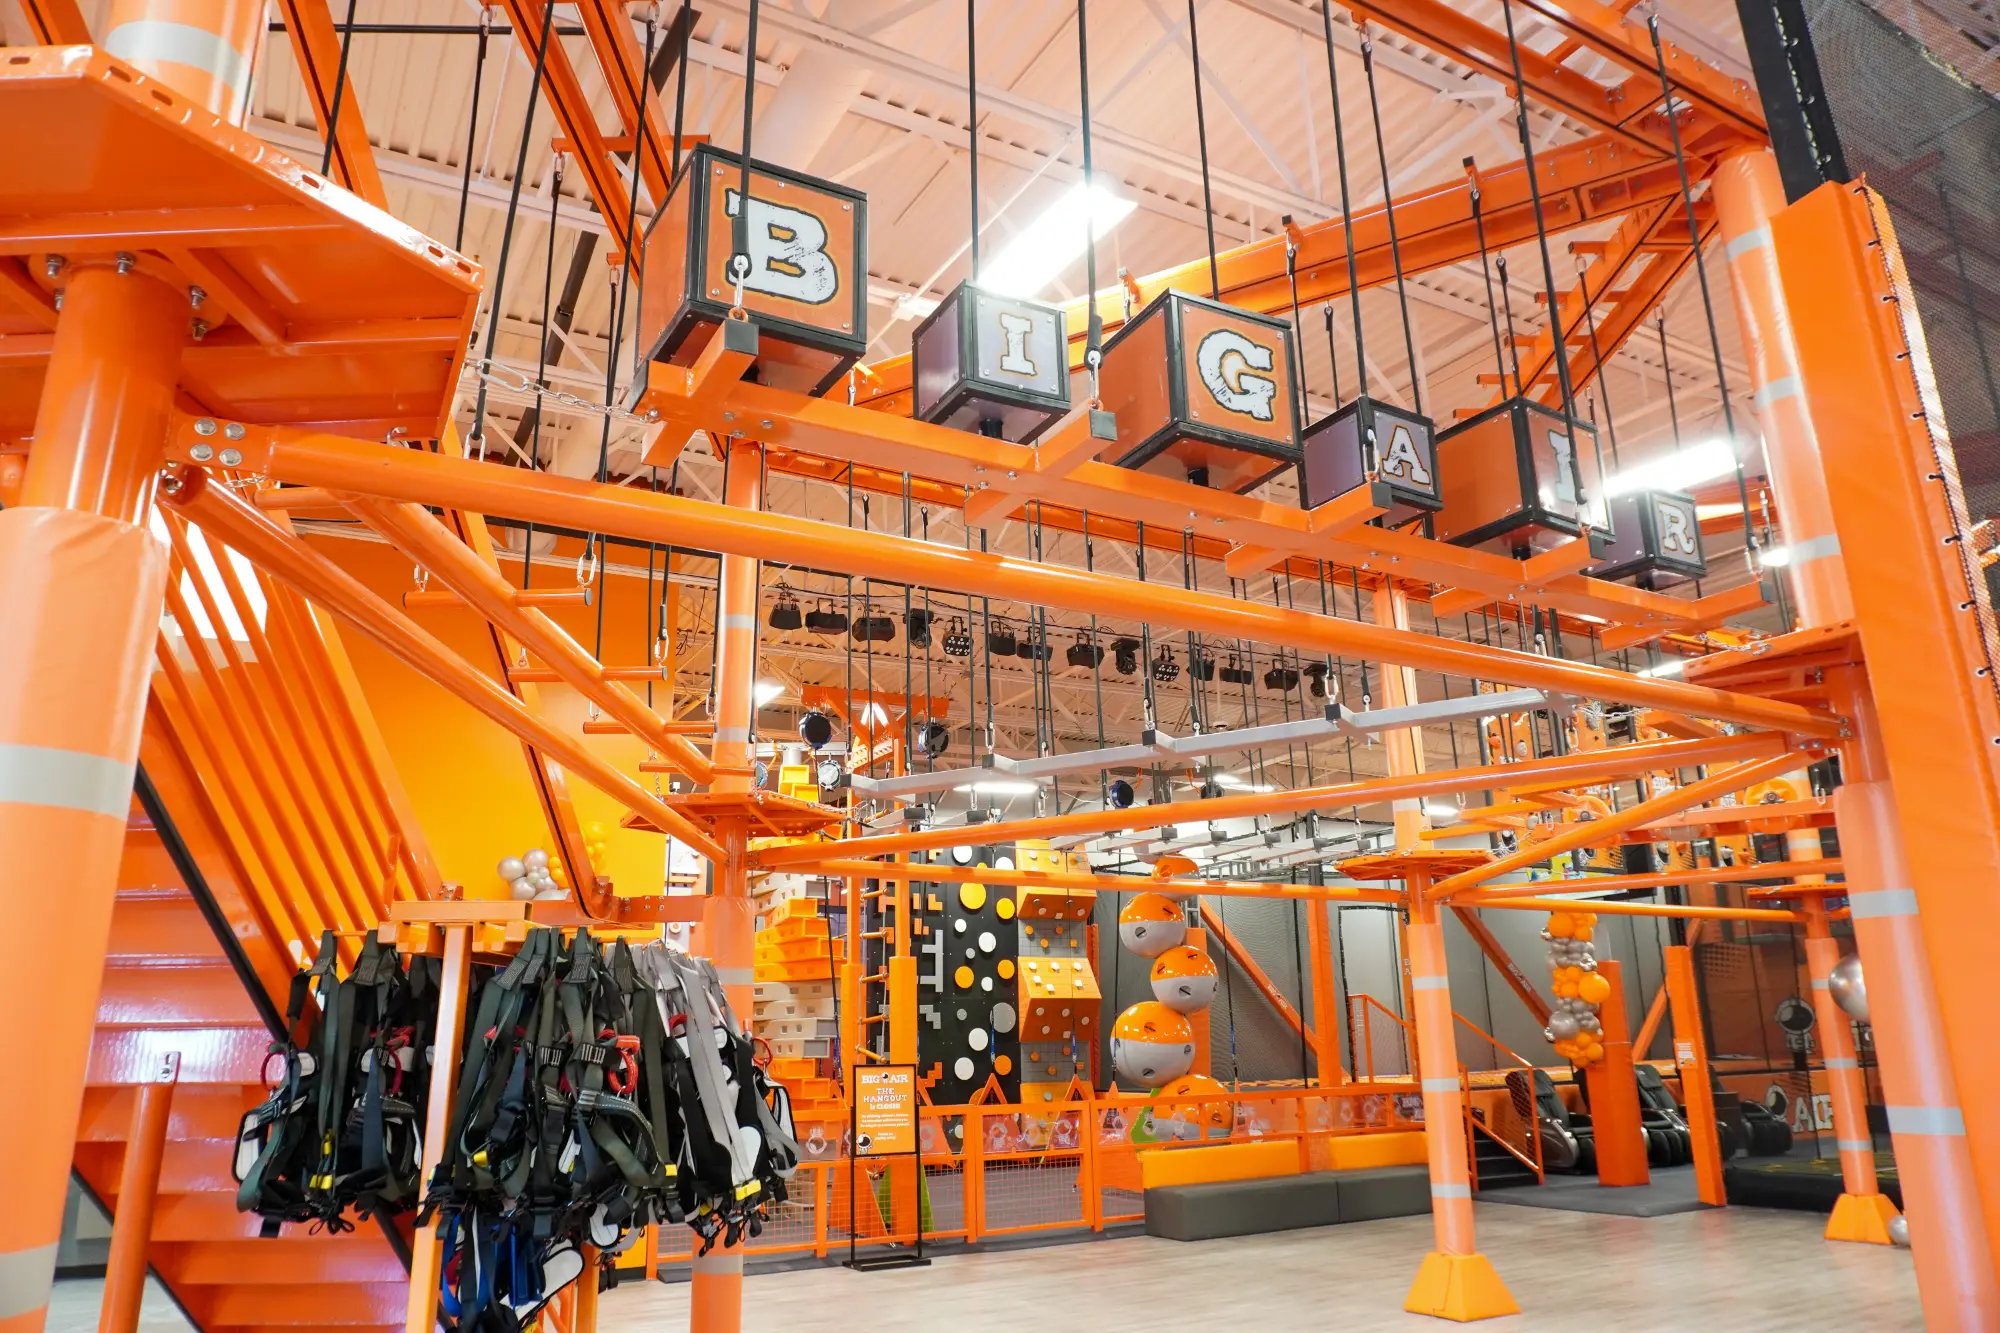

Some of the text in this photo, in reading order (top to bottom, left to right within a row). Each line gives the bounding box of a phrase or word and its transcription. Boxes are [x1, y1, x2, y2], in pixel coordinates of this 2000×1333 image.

[861, 1074, 909, 1084] BIG AIR
[863, 1095, 907, 1103] HANGOUT
